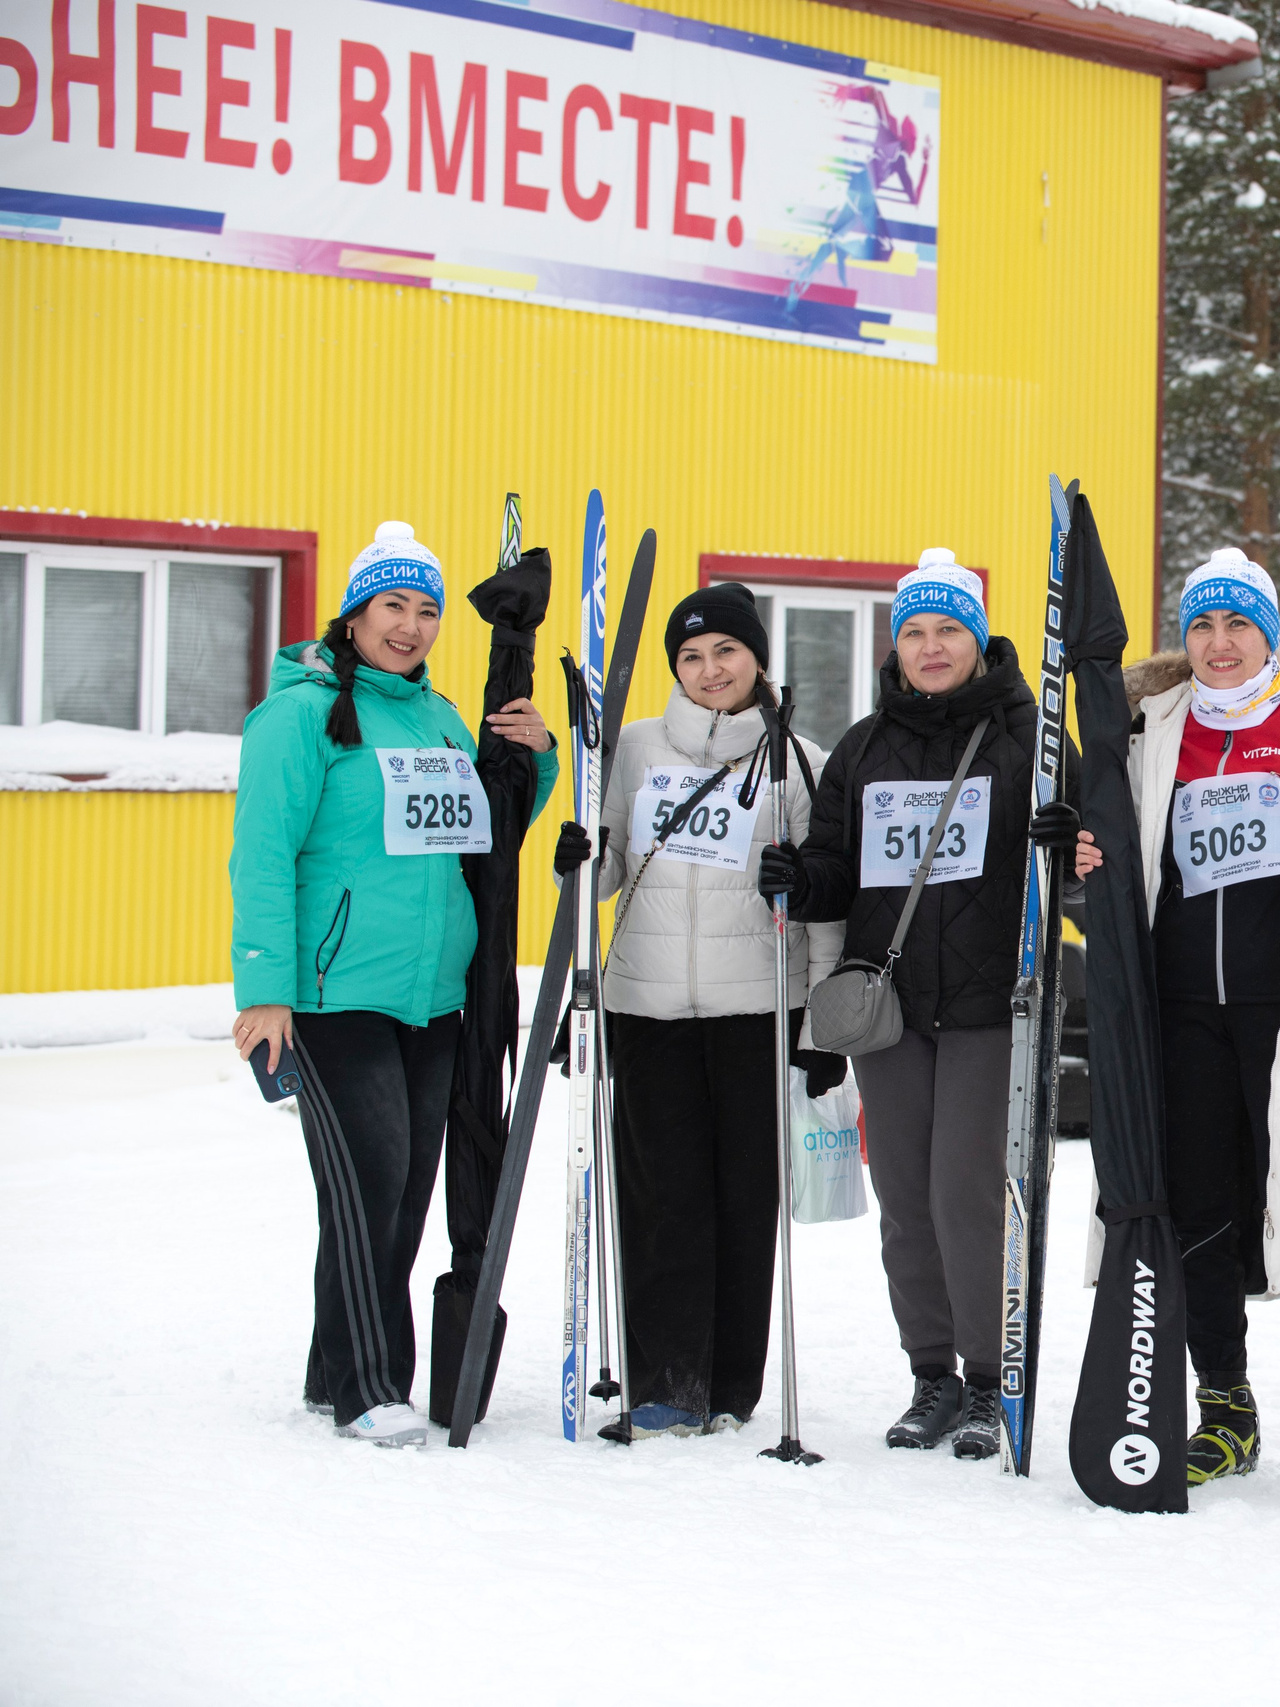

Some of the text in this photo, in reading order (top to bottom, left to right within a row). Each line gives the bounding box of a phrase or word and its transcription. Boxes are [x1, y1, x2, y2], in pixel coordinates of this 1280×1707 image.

[338, 38, 746, 250] ВМЕСТЕ!
[352, 565, 419, 595] РОССИИ
[892, 589, 948, 617] ОССИИ
[414, 757, 447, 765] ЛЫЖНЯ
[414, 764, 451, 773] РОССИИ
[904, 798, 945, 808] РОССИ
[1201, 792, 1250, 808] РОССИИ
[1202, 784, 1248, 798] ЛЫЖНЯ
[406, 794, 472, 829] 5285
[652, 799, 731, 841] 5003
[884, 822, 966, 860] 5123
[1190, 819, 1267, 866] 5063
[816, 1150, 856, 1162] ATOMY
[577, 1198, 588, 1345] BOLZANO
[564, 1322, 573, 1347] 180
[1002, 1288, 1025, 1398] OMNI
[1126, 1258, 1155, 1428] NORDWAY
